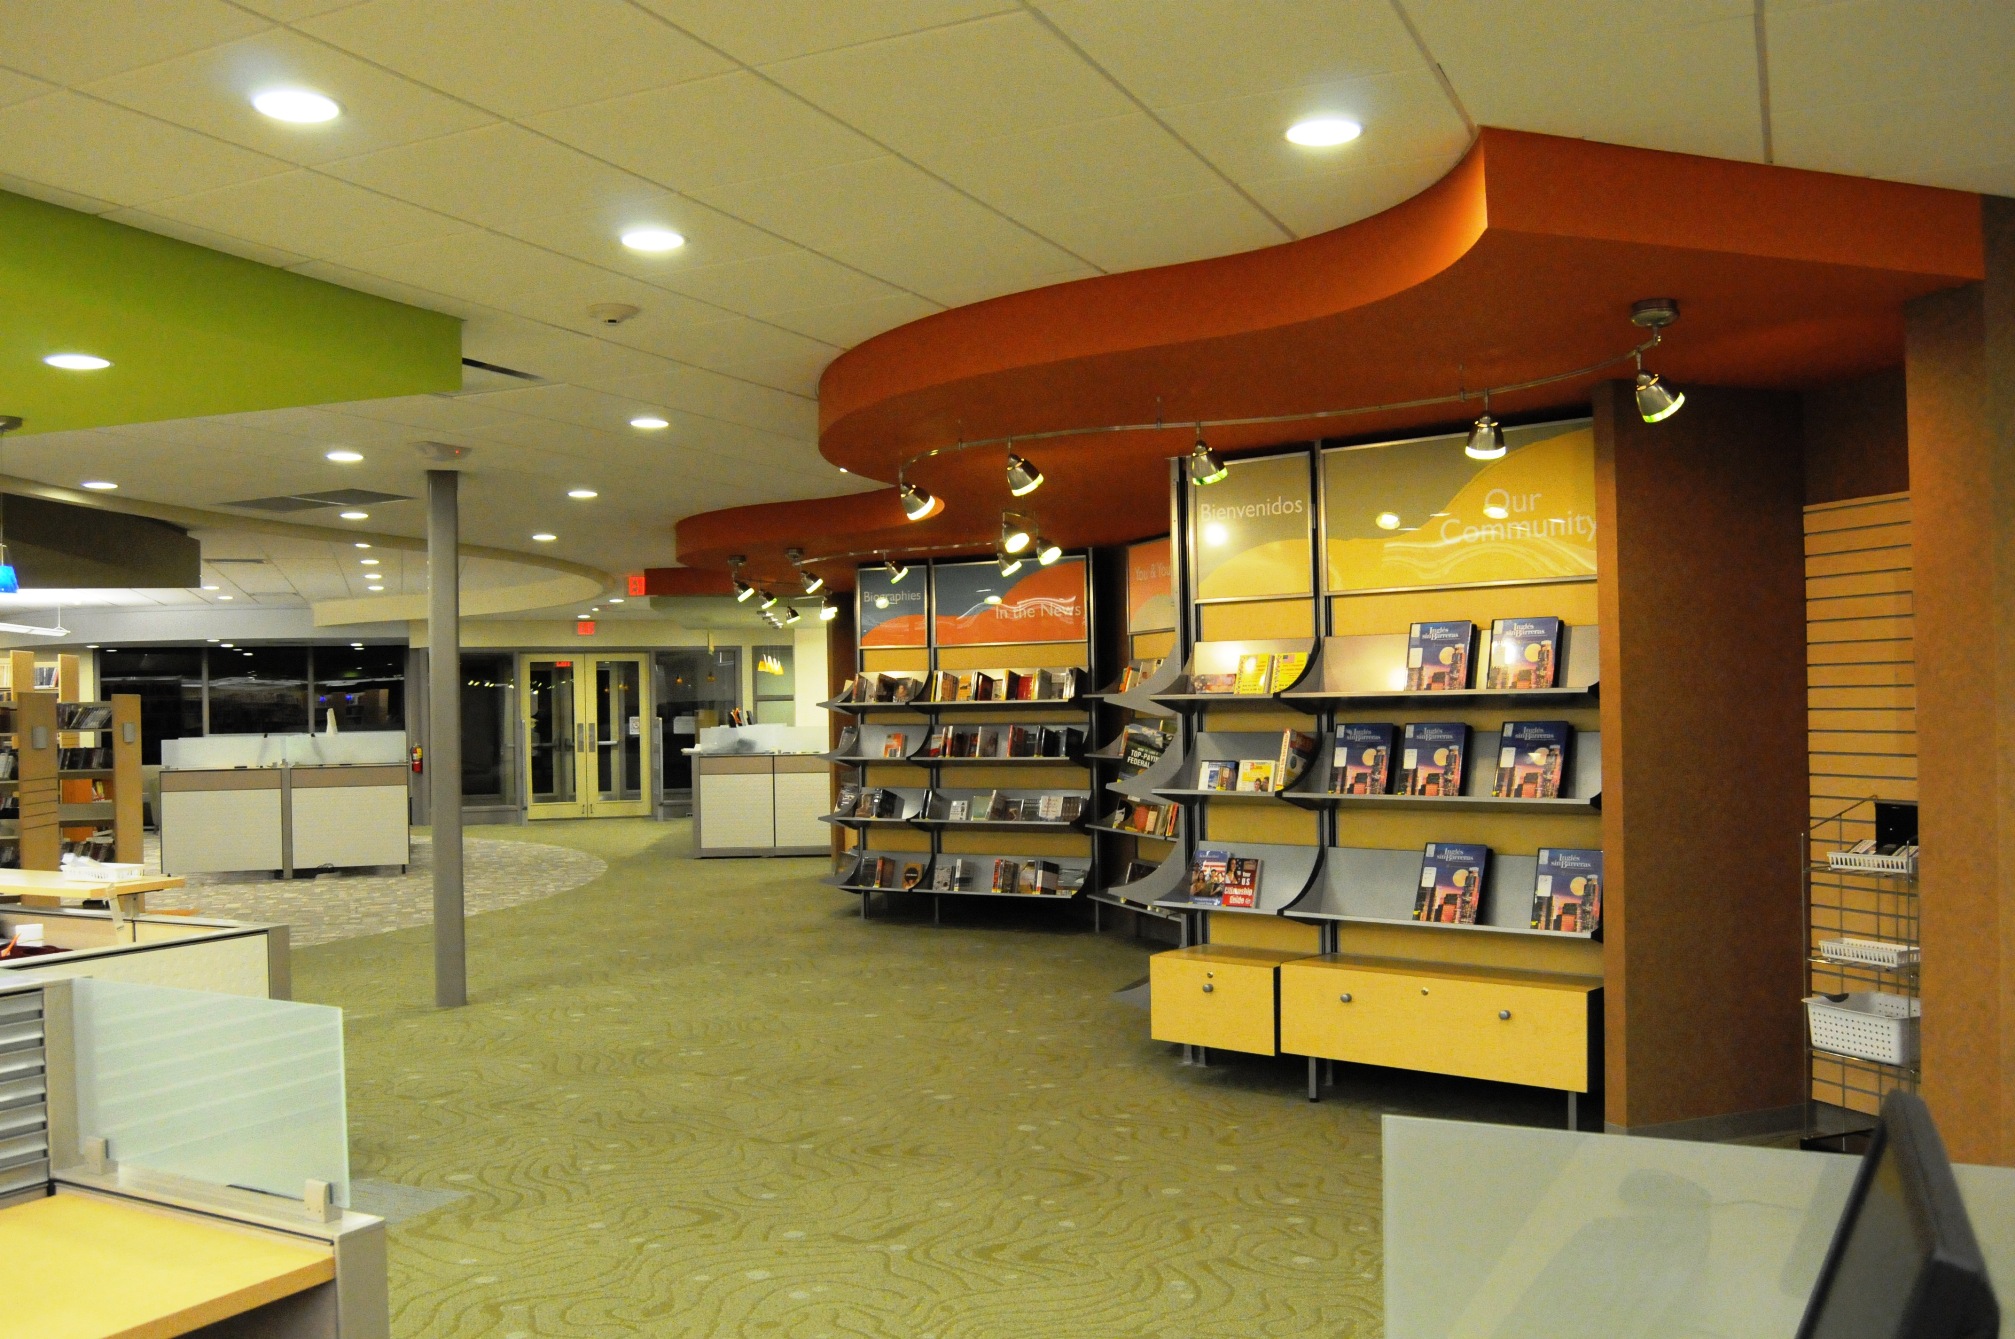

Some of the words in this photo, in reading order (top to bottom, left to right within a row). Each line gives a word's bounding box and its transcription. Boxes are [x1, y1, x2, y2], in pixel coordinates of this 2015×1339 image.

[1200, 496, 1303, 521] Bienvenidos
[1484, 488, 1542, 518] Our
[1440, 510, 1597, 543] Community
[995, 605, 1008, 619] In
[1013, 606, 1036, 619] the
